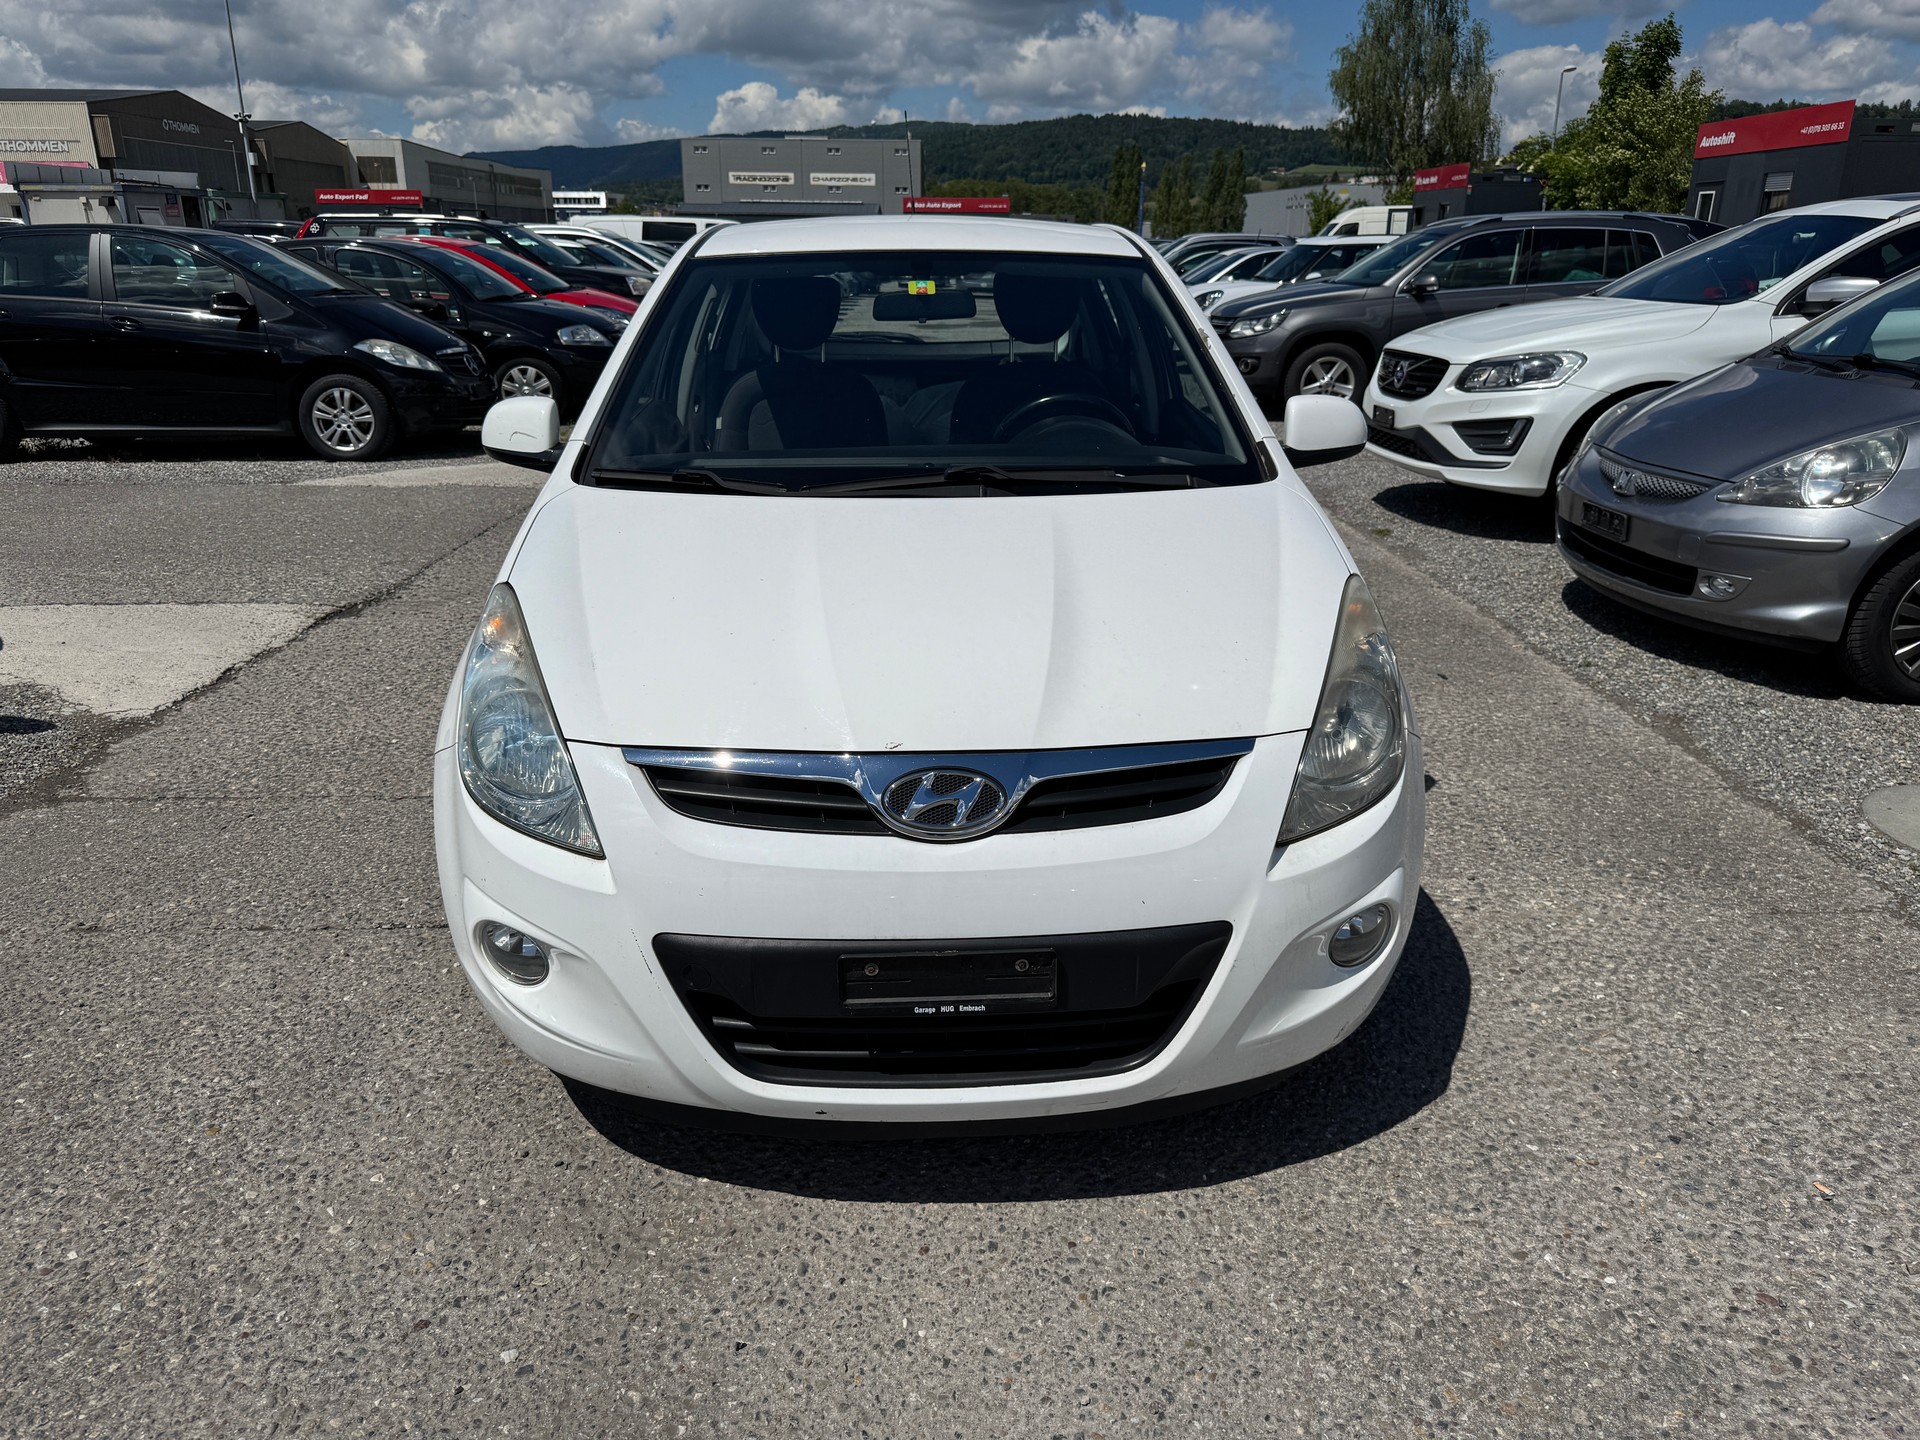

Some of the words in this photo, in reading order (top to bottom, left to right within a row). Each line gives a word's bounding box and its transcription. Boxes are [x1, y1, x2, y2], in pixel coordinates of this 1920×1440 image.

[168, 120, 200, 134] THOMMEN
[1700, 131, 1736, 148] Autoshift
[0, 141, 69, 152] THOMMEN
[334, 193, 354, 201] Export
[940, 1005, 955, 1013] HUG
[959, 1004, 986, 1012] Embrach
